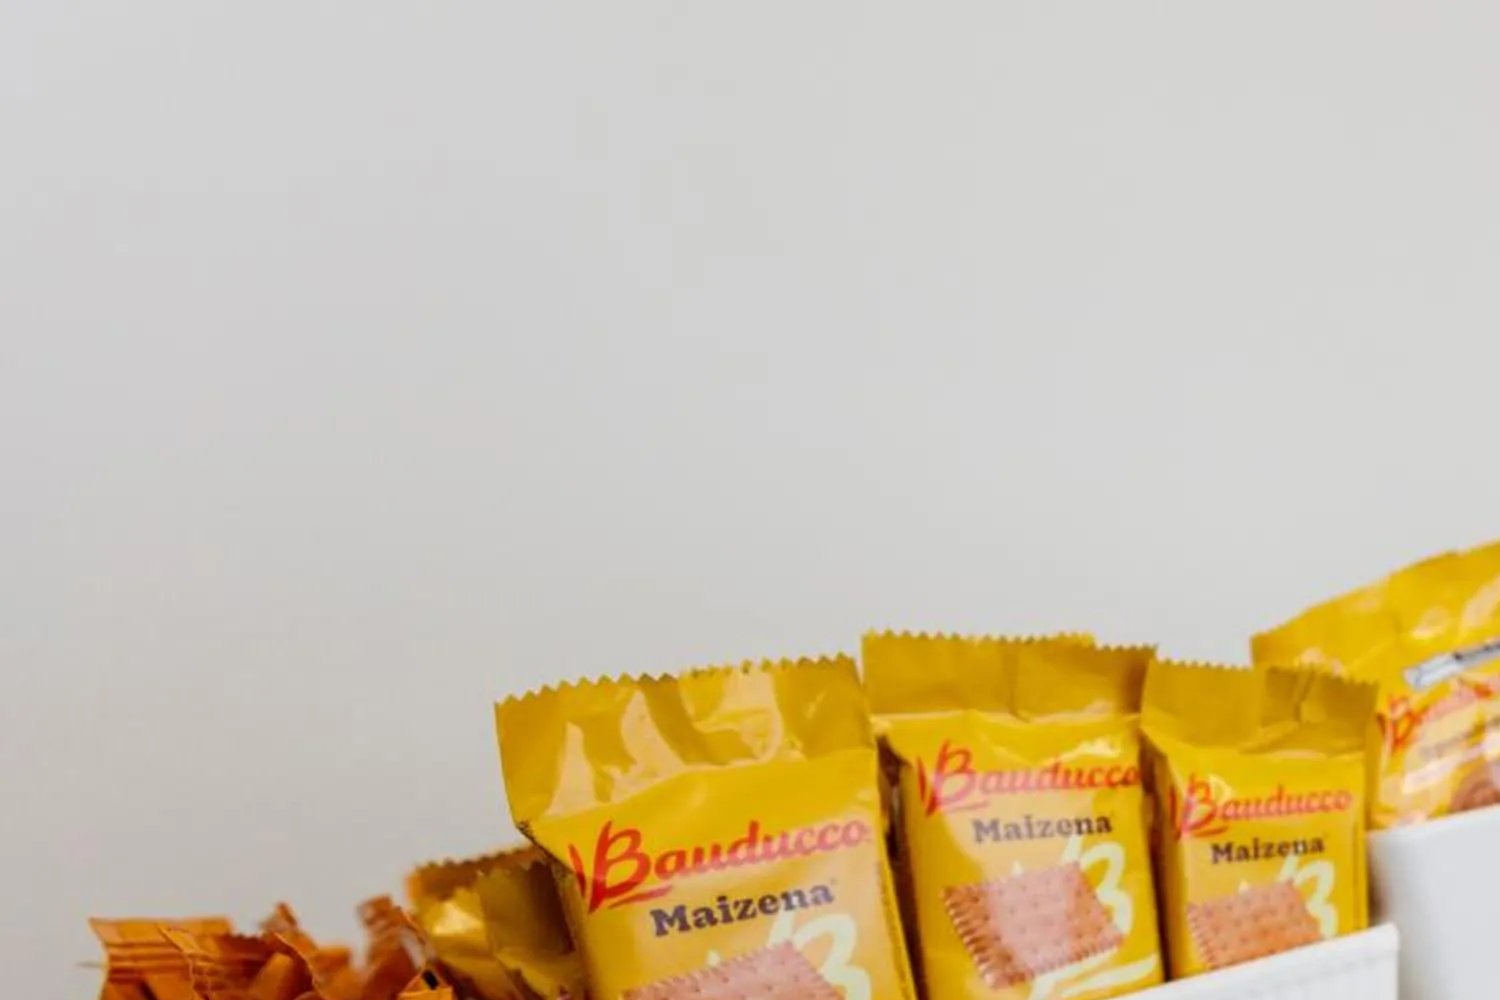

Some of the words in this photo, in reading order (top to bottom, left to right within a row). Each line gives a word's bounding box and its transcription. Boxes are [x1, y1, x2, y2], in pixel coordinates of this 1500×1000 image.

[918, 739, 1140, 816] Bauducco
[1169, 774, 1353, 840] Bauducco
[971, 813, 1113, 844] Maizena
[1210, 836, 1326, 865] Maizena
[567, 820, 870, 915] Bauducco
[650, 883, 835, 938] Maizena
